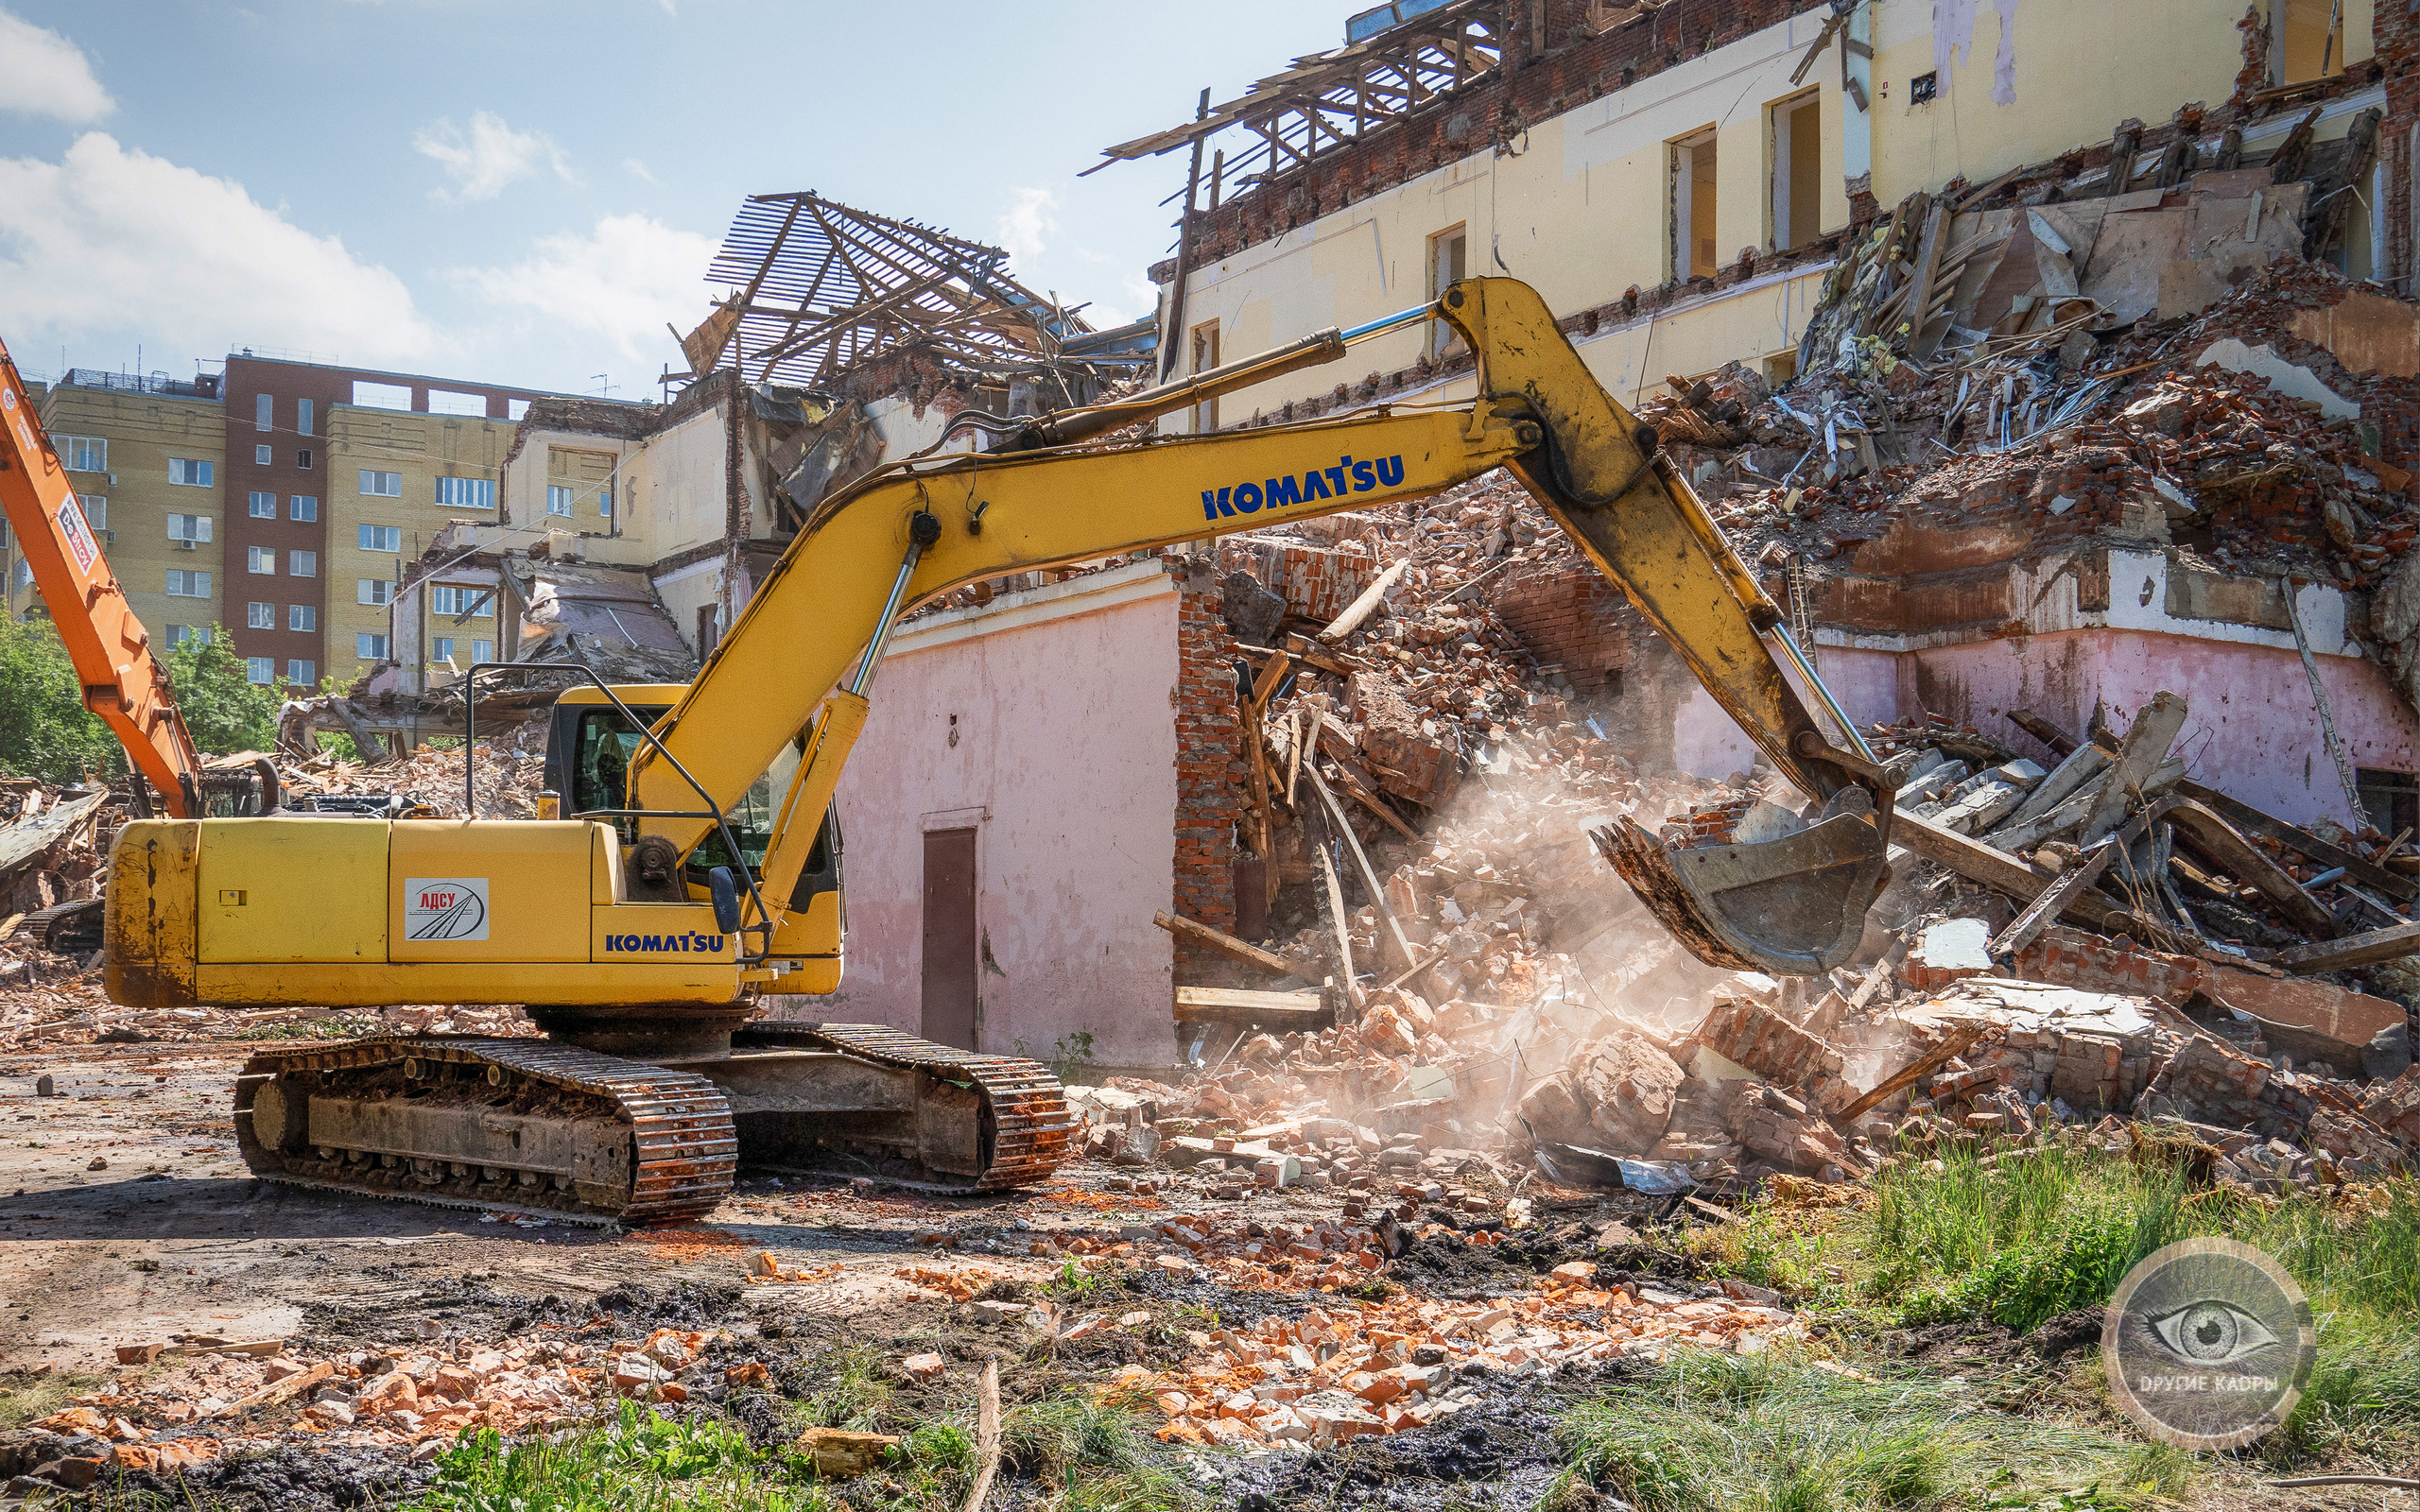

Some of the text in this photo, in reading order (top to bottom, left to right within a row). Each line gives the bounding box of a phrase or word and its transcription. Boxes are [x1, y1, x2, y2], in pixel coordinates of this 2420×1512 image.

[1201, 455, 1406, 521] KOMATSU
[420, 893, 456, 910] ЛДСУ
[606, 930, 724, 953] KOMATSU
